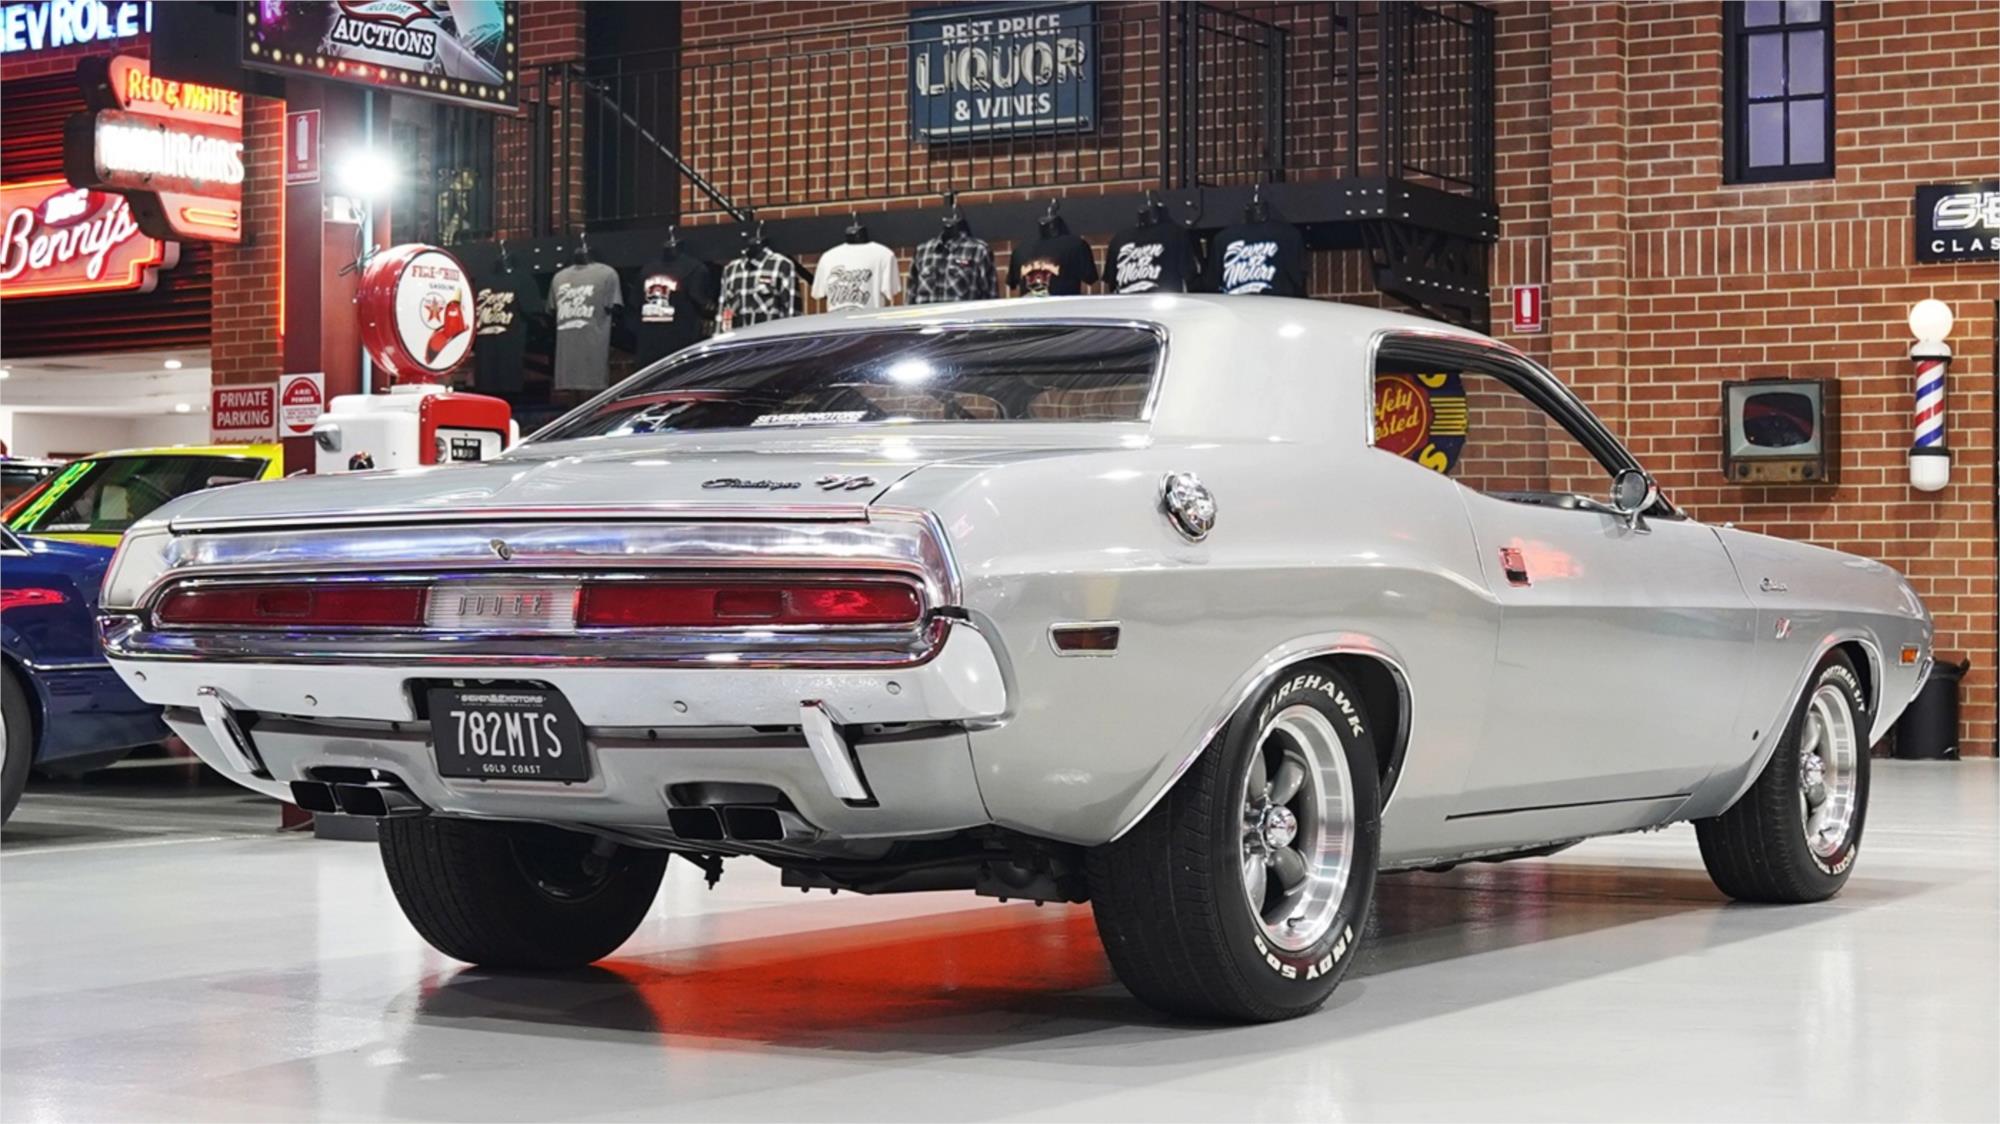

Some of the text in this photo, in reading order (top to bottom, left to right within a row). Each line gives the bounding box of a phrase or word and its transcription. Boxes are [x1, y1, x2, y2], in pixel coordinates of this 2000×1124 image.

[333, 17, 434, 56] AUCTIONS
[942, 14, 1061, 45] BEST PRICE
[916, 38, 1087, 96] LIQUOR
[954, 92, 1051, 121] & WINES
[0, 196, 139, 280] Benny's
[1117, 242, 1164, 268] Seven
[1224, 240, 1279, 268] Seven
[1116, 261, 1162, 286] Motors
[1223, 262, 1276, 288] Motors
[220, 390, 268, 408] PRIVATE
[217, 410, 270, 427] PARKING
[450, 710, 562, 758] 782MTS
[482, 763, 541, 774] GOLD COAST
[1254, 924, 1354, 980] INDY 500
